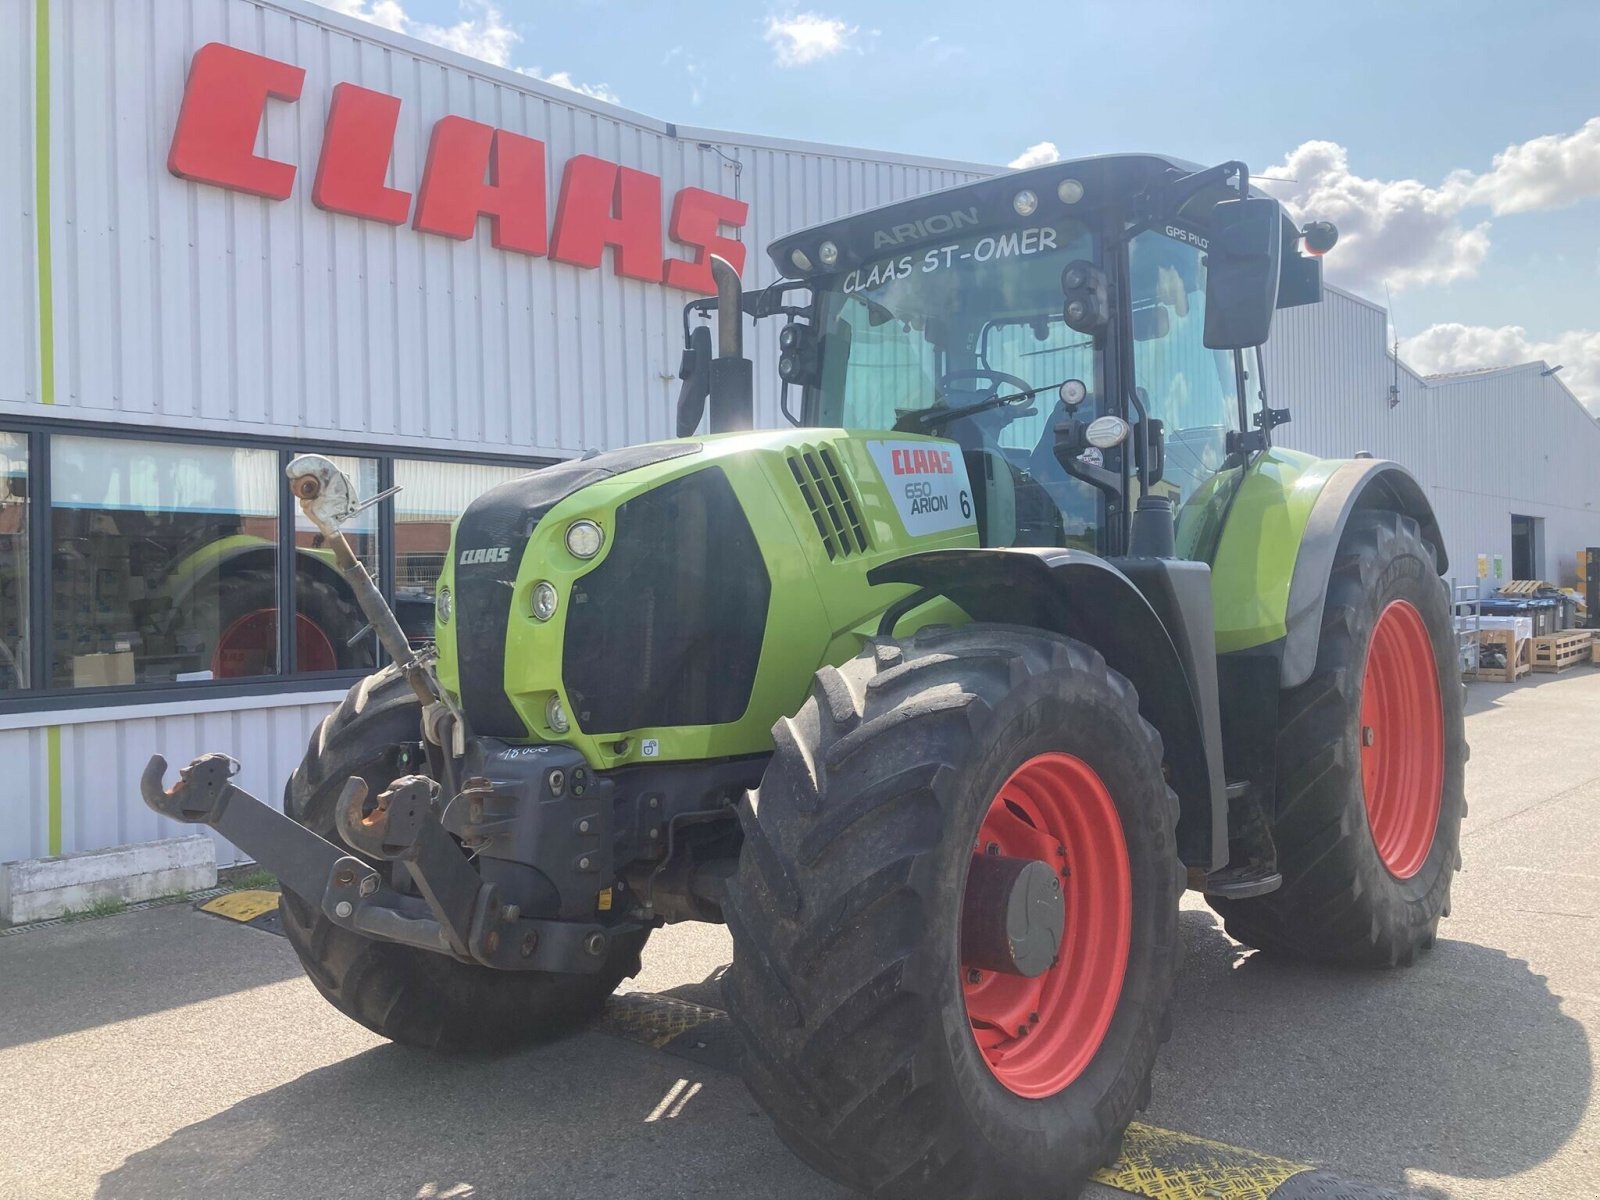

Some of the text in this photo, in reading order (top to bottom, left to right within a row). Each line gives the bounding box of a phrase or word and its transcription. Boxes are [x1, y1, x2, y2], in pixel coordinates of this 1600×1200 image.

[167, 42, 749, 296] CLAAS
[873, 206, 980, 250] ARION
[1165, 224, 1187, 241] GPS
[842, 226, 1057, 294] CLAAS ST-OMER
[891, 448, 954, 476] CLAAS
[904, 481, 932, 500] 650
[959, 489, 972, 520] 6
[910, 494, 949, 516] ARION
[459, 546, 512, 566] CLAAS
